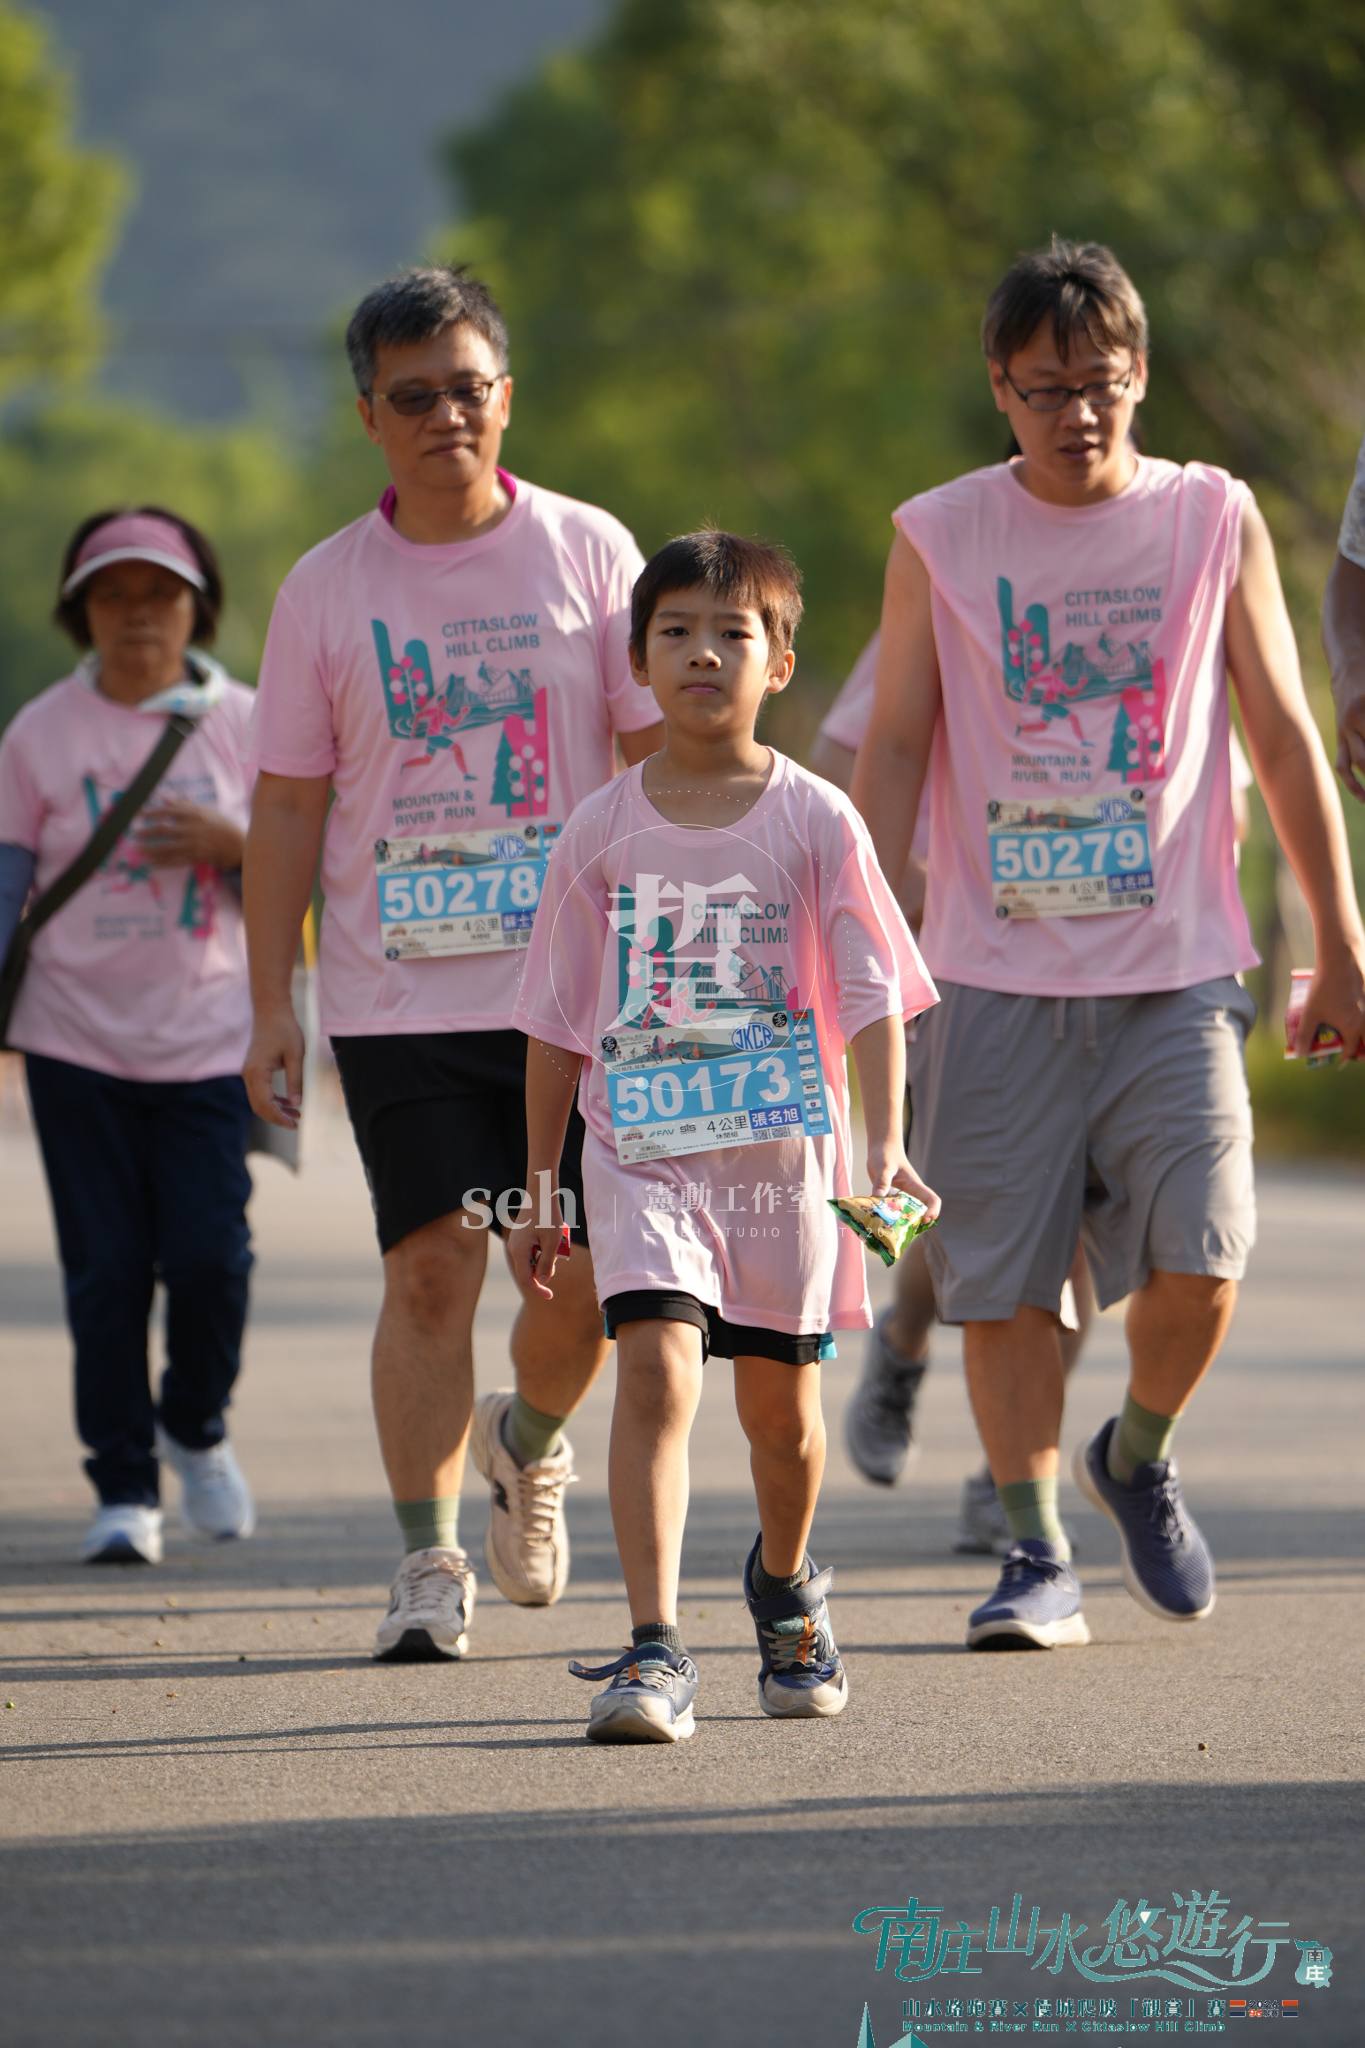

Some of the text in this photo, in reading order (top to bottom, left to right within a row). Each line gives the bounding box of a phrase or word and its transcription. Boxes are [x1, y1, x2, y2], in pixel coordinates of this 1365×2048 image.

[1064, 586, 1162, 608] CITTASLOW
[441, 613, 538, 638] CITTASLOW
[1065, 607, 1163, 627] HILL CLIMB
[445, 632, 541, 658] HILL CLIMB
[1012, 753, 1077, 767] MOUNTAIN
[1012, 770, 1091, 783] RIVER RUN
[392, 789, 474, 811] MOUNTAIN &
[395, 806, 476, 827] RIVER RUN
[996, 828, 1145, 878] 50279
[383, 866, 539, 920] 50278
[691, 903, 790, 920] CITTASLOW
[692, 927, 789, 944] HILL CLIMB
[735, 1023, 774, 1050] JKCR
[616, 1057, 792, 1122] 50173
[706, 1115, 749, 1133] 4公里
[751, 1107, 800, 1127] 張名旭
